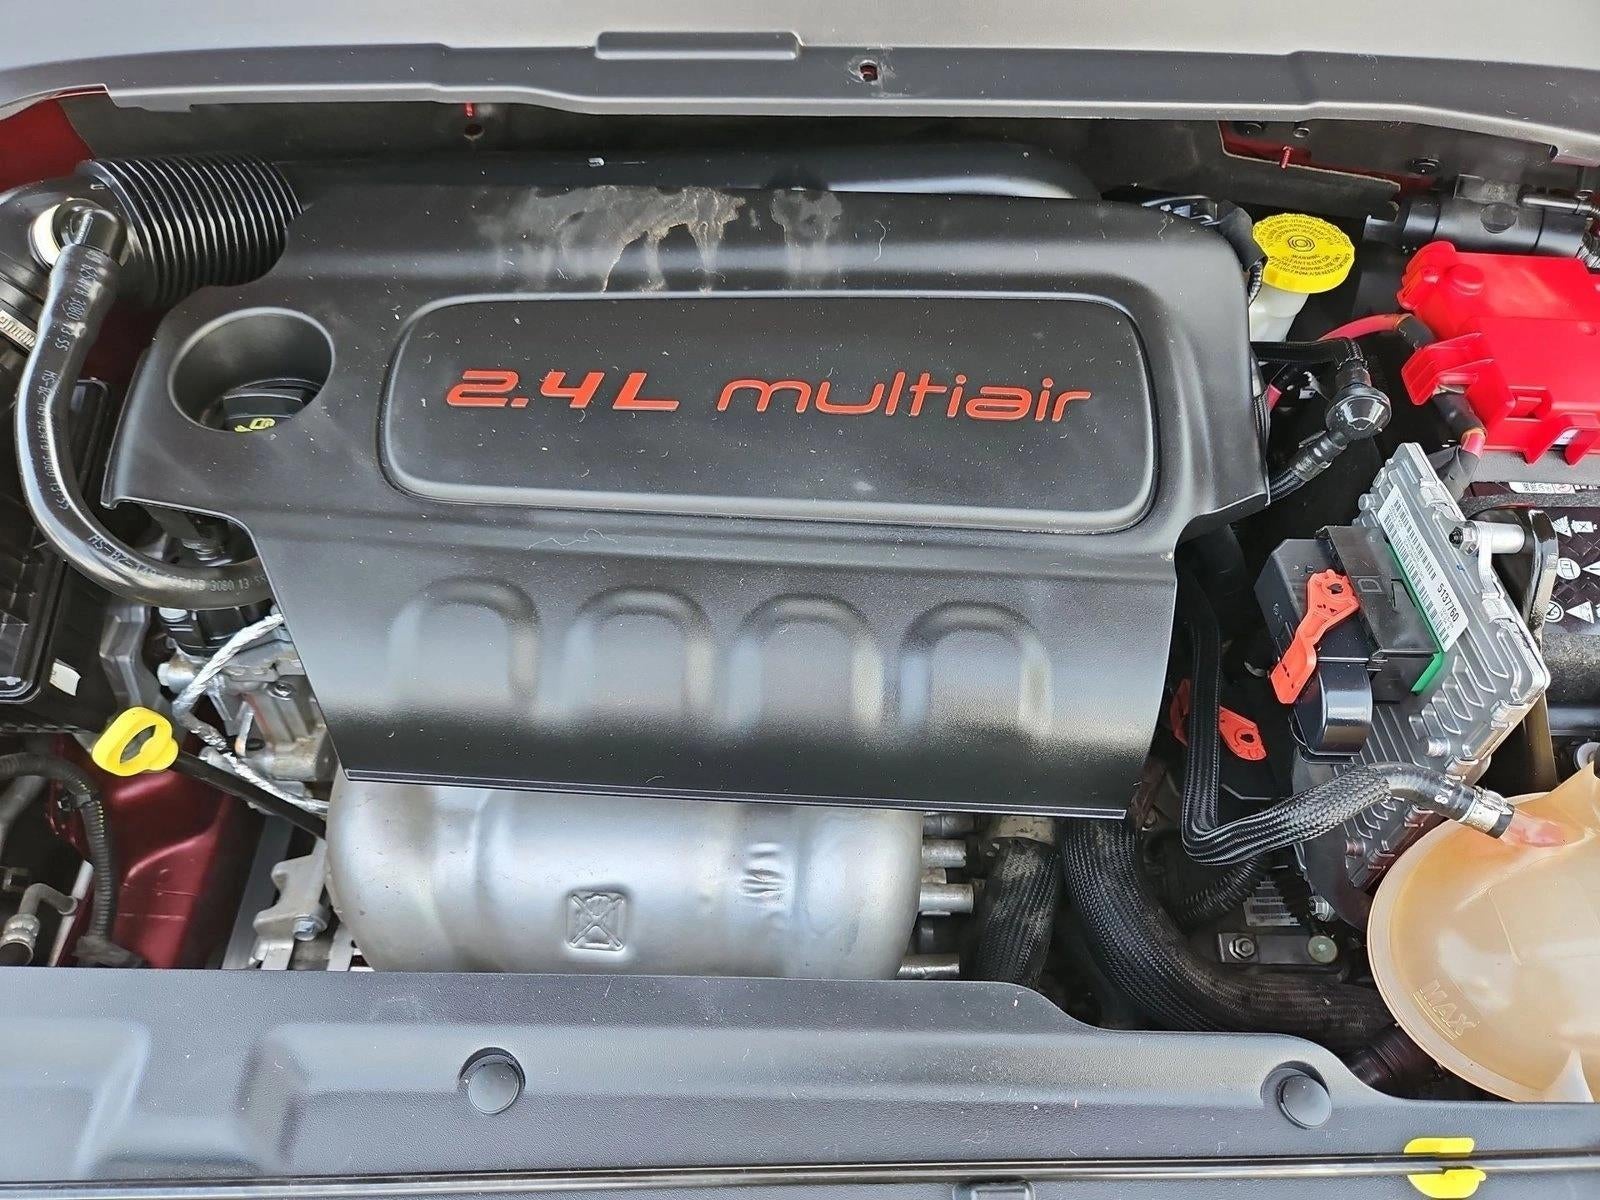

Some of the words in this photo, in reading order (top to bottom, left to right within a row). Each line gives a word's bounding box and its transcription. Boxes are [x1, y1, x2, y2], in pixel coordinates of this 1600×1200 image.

[717, 371, 1092, 421] multiair
[1437, 582, 1460, 622] 5137760
[1417, 978, 1481, 1037] MAX
